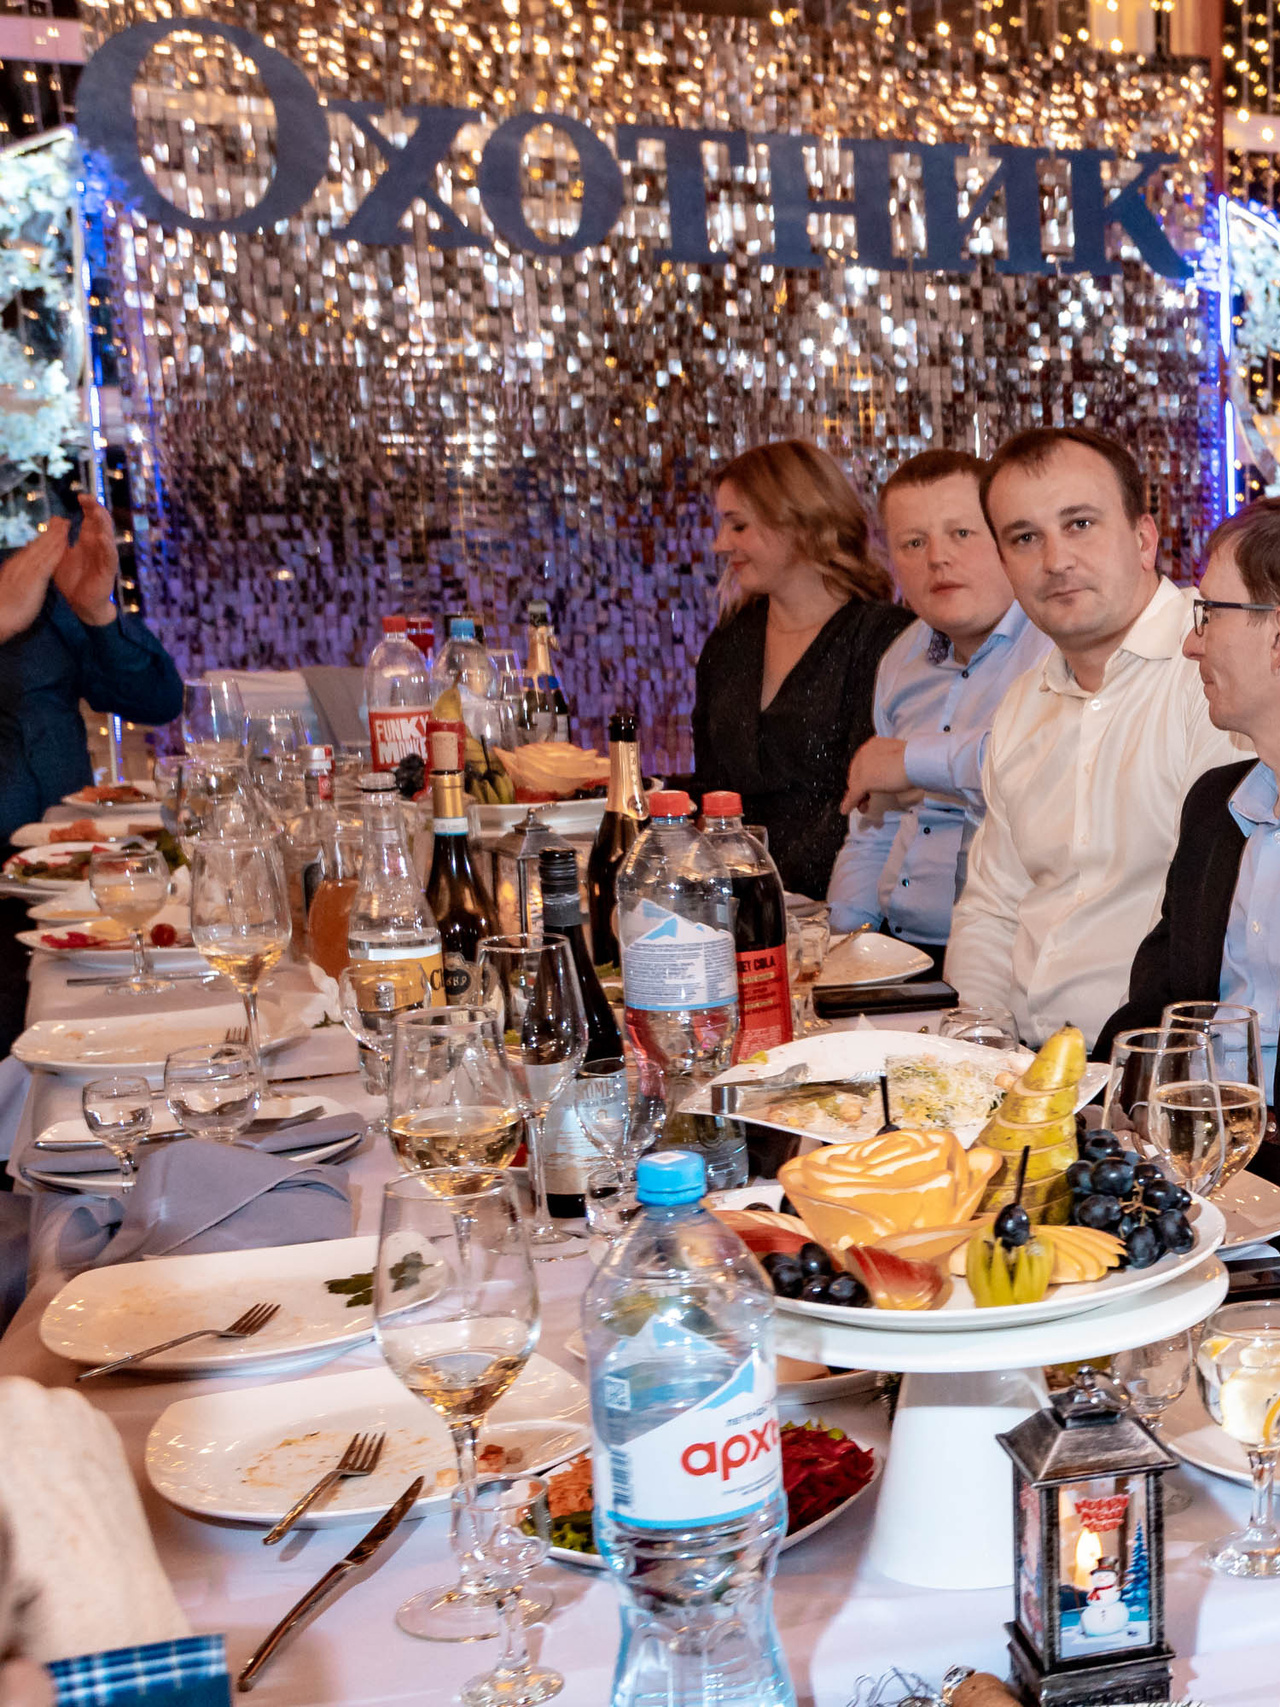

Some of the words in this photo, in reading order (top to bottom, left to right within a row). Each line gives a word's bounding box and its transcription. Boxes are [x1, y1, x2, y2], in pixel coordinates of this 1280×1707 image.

[77, 17, 1192, 279] Охотник
[375, 714, 428, 742] FUNKY
[379, 737, 428, 764] MONKE
